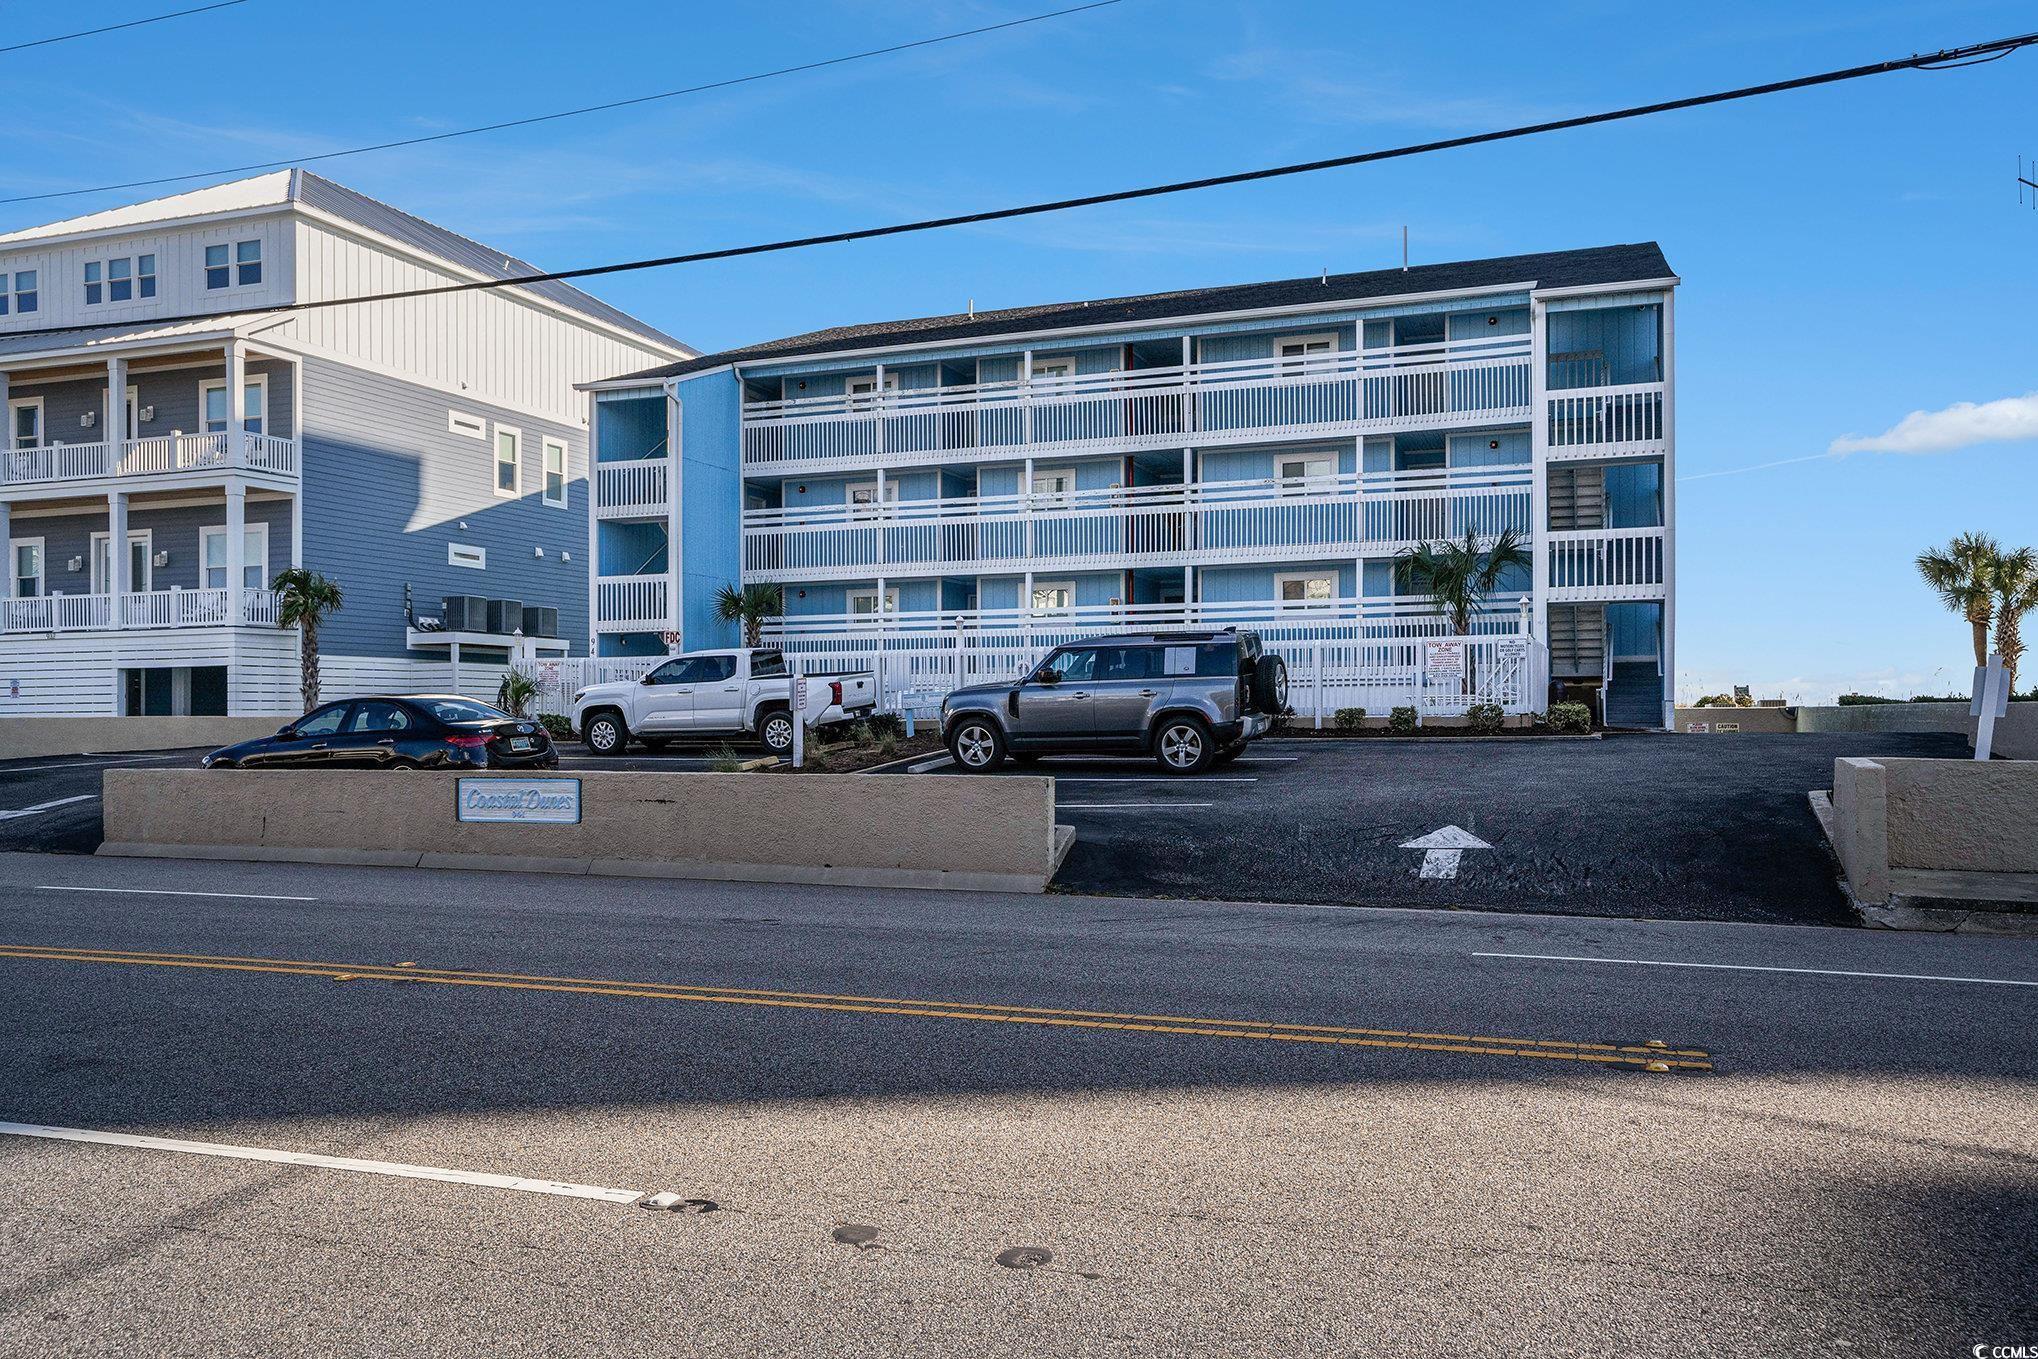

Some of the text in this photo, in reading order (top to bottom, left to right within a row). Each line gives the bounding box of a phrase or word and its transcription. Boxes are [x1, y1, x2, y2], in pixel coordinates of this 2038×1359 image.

[665, 632, 680, 643] FDC
[466, 788, 574, 810] Coastal Dunes
